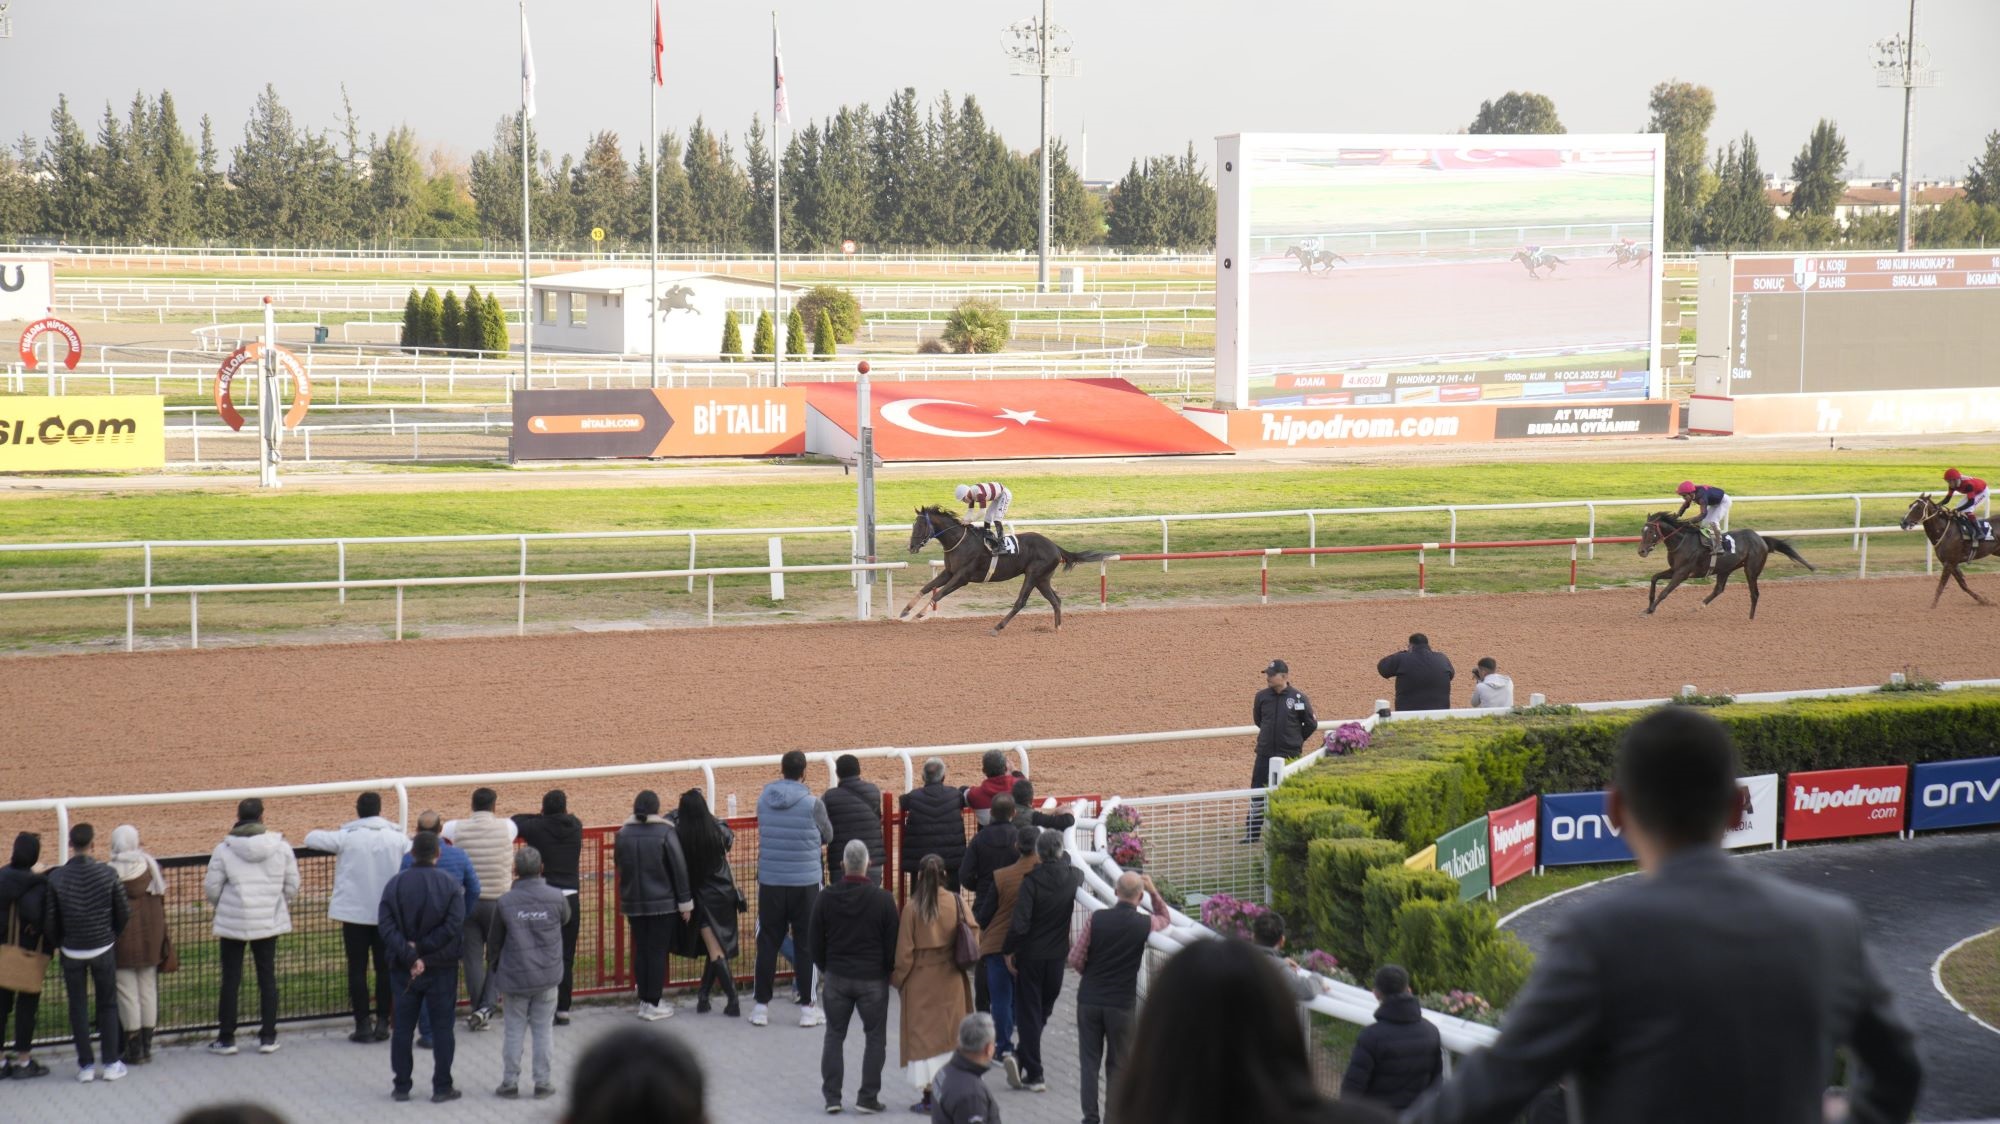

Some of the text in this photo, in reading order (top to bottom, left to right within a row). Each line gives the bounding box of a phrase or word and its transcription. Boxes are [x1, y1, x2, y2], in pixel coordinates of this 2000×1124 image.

[1826, 259, 1848, 274] KOŞU
[1876, 259, 1892, 270] 1500
[1892, 258, 1909, 270] KUM
[1946, 257, 1955, 269] 21
[1753, 278, 1785, 292] SONUÇ
[1892, 275, 1938, 287] SIRALAMA
[1741, 309, 1747, 321] 2
[47, 320, 80, 352] HİPODROMU
[1741, 323, 1746, 335] 3
[1740, 353, 1745, 364] 5
[1294, 376, 1326, 387] ADANA
[1530, 373, 1546, 381] KUM
[1732, 368, 1752, 379] Süre
[1554, 408, 1614, 421] AT YARIŞI
[1261, 413, 1460, 446] hipodrom.com
[1527, 421, 1641, 435] BURADA OYNANIR!
[1004, 536, 1016, 554] 4
[1794, 784, 1901, 814] hipodrom
[1867, 806, 1897, 820] .com
[1493, 819, 1535, 855] hipodrom
